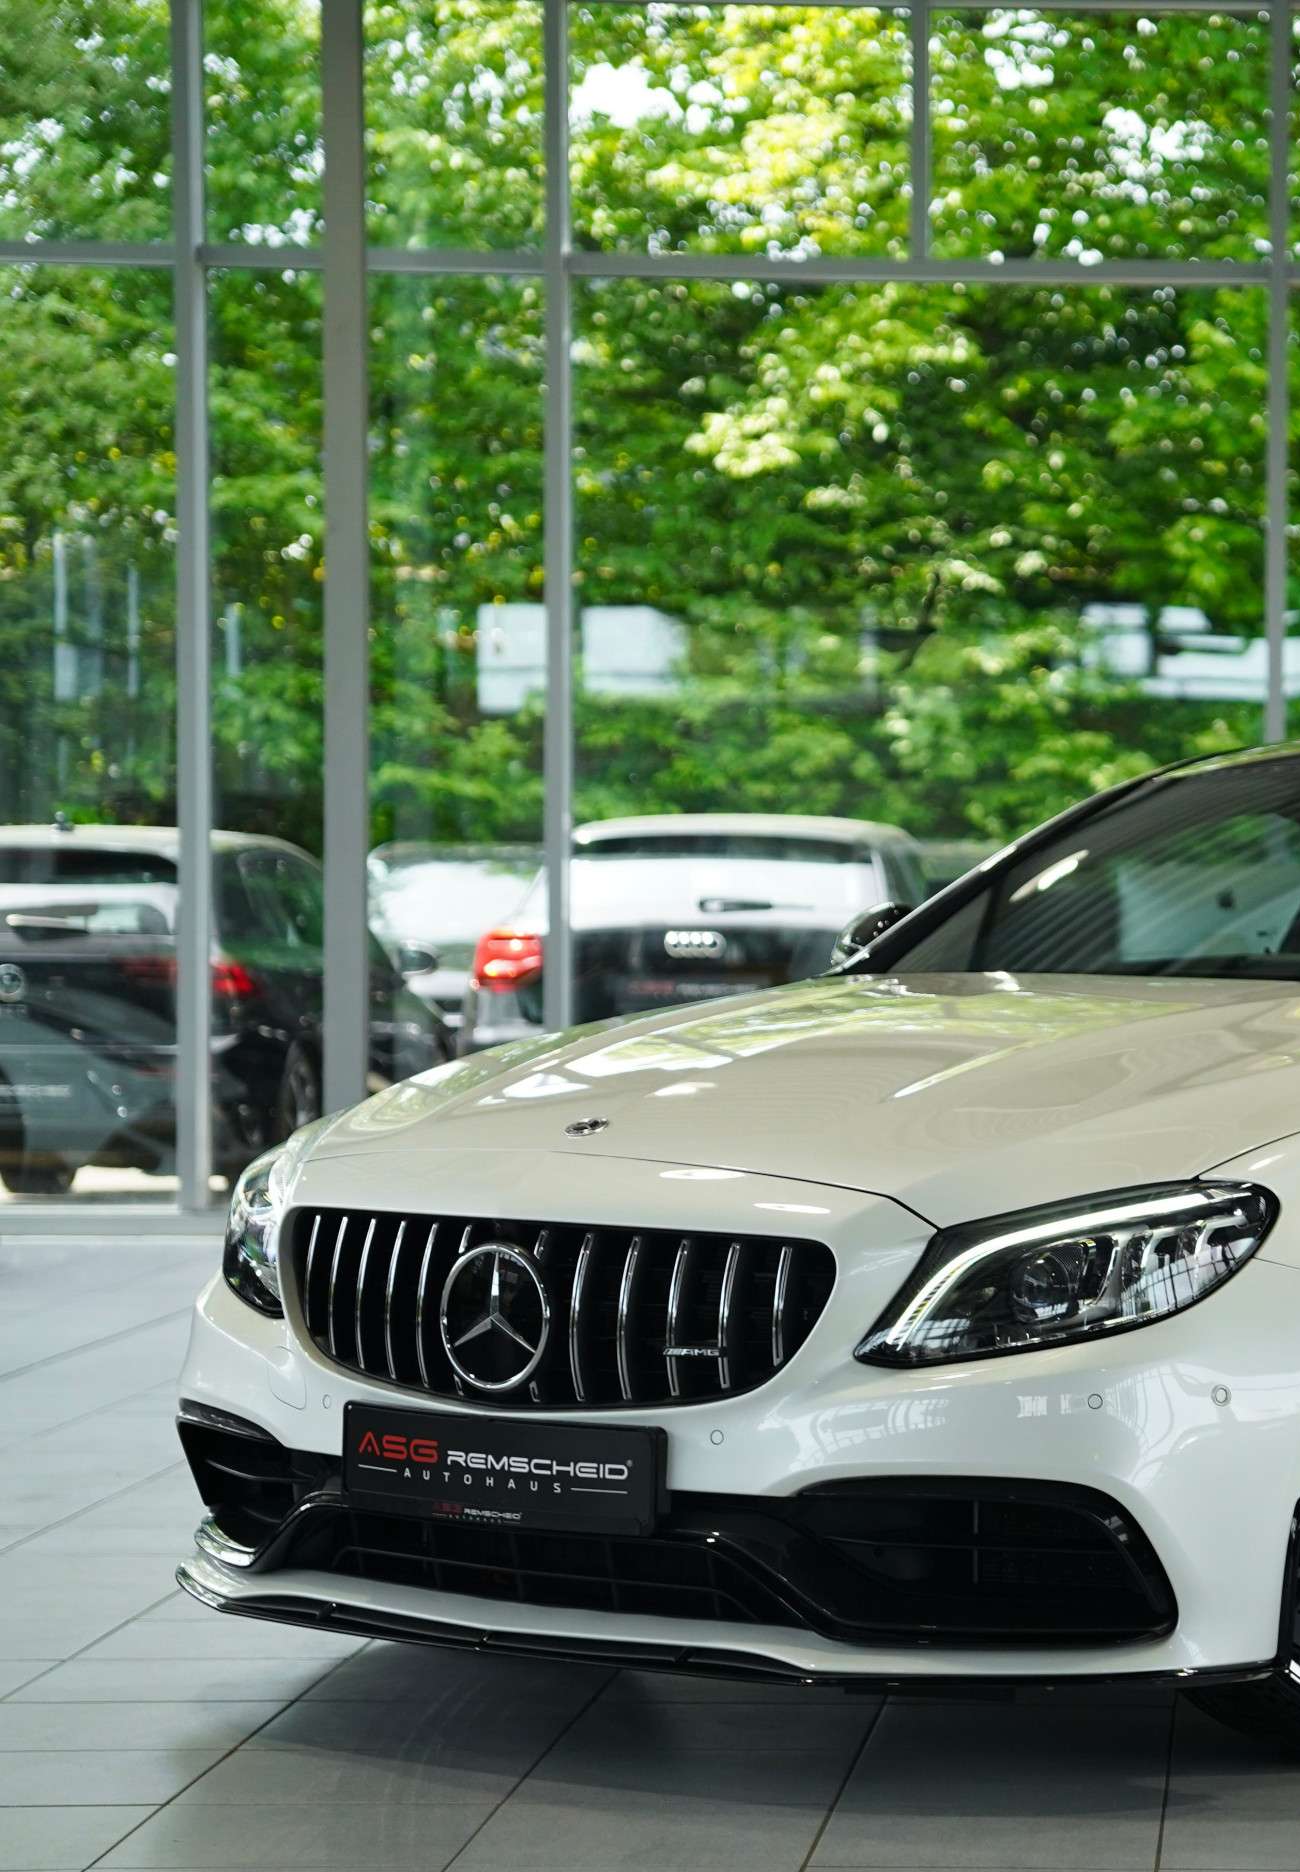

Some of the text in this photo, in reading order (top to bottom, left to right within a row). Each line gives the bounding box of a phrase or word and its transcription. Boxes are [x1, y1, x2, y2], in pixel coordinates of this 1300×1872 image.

[359, 1431, 629, 1480] ASG REMSCHEID
[403, 1467, 562, 1494] AUTOHAUS
